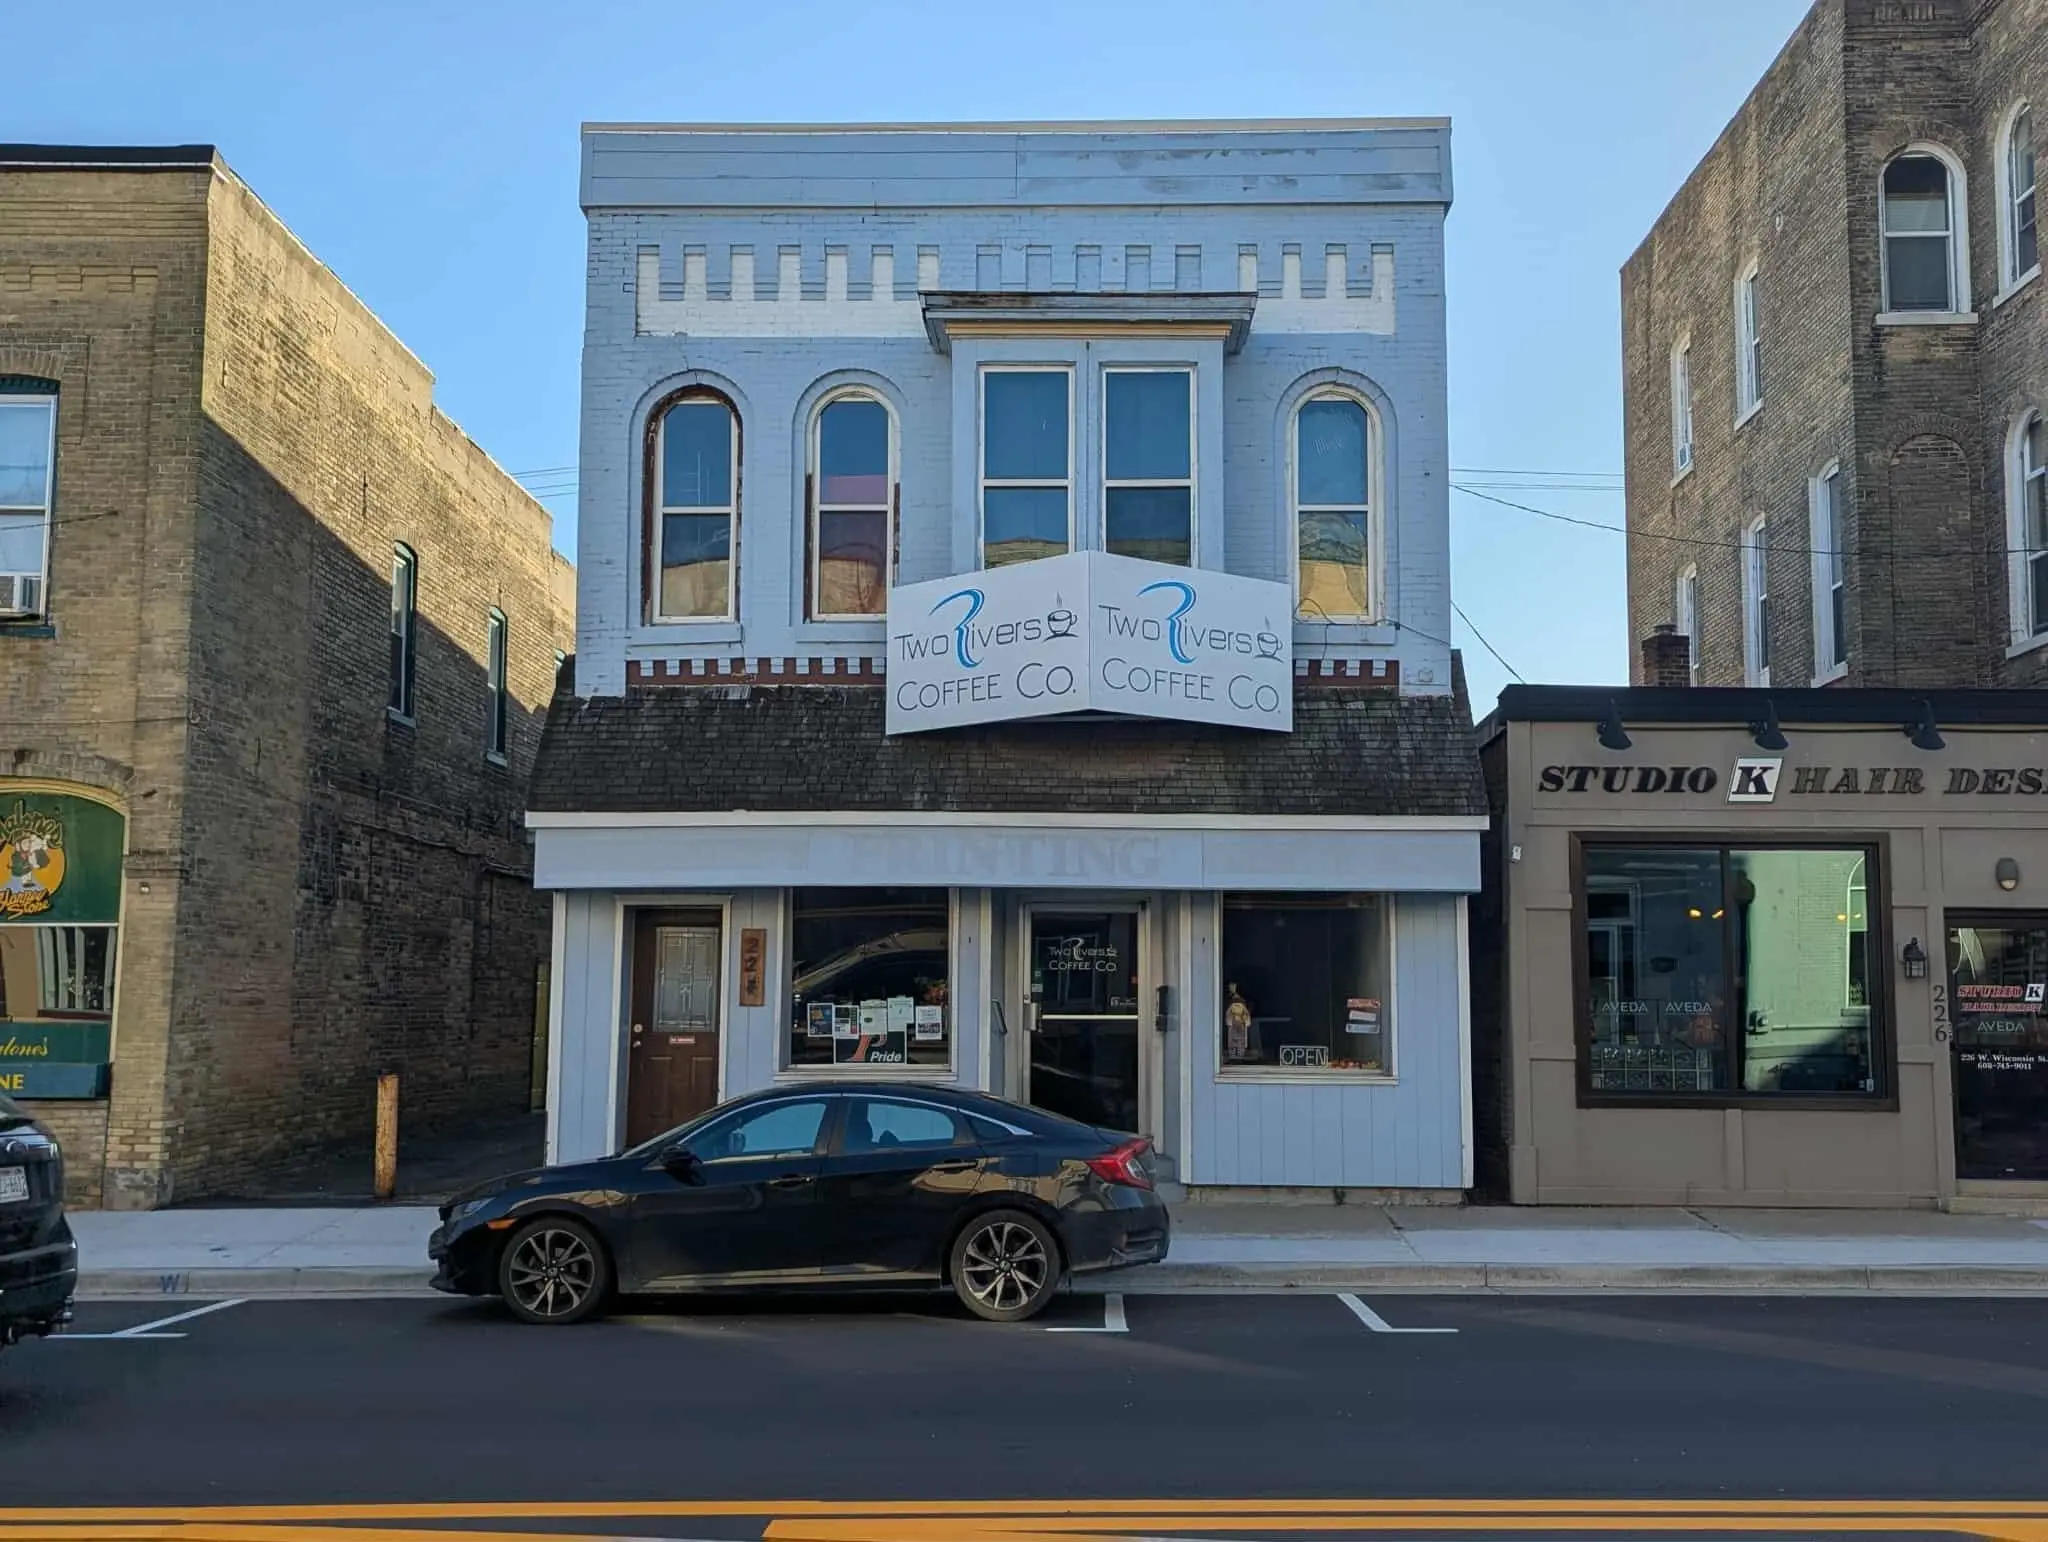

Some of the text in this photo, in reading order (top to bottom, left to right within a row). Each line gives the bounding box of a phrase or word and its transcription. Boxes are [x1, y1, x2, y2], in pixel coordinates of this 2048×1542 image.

[1098, 604, 1160, 641] Two
[894, 633, 949, 661] Two
[1538, 765, 1717, 794] STUDIO
[1731, 765, 1773, 795] K
[1790, 767, 1925, 796] HAIR
[849, 833, 1161, 877] PRINTING
[2028, 985, 2042, 999] K
[1602, 1001, 1648, 1012] AVEDA
[1665, 1001, 1713, 1012] AVEDA
[1933, 985, 1947, 1041] 226
[1977, 1021, 2025, 1032] AVEDA
[870, 1051, 902, 1062] Pride
[1281, 1048, 1327, 1066] OPEN
